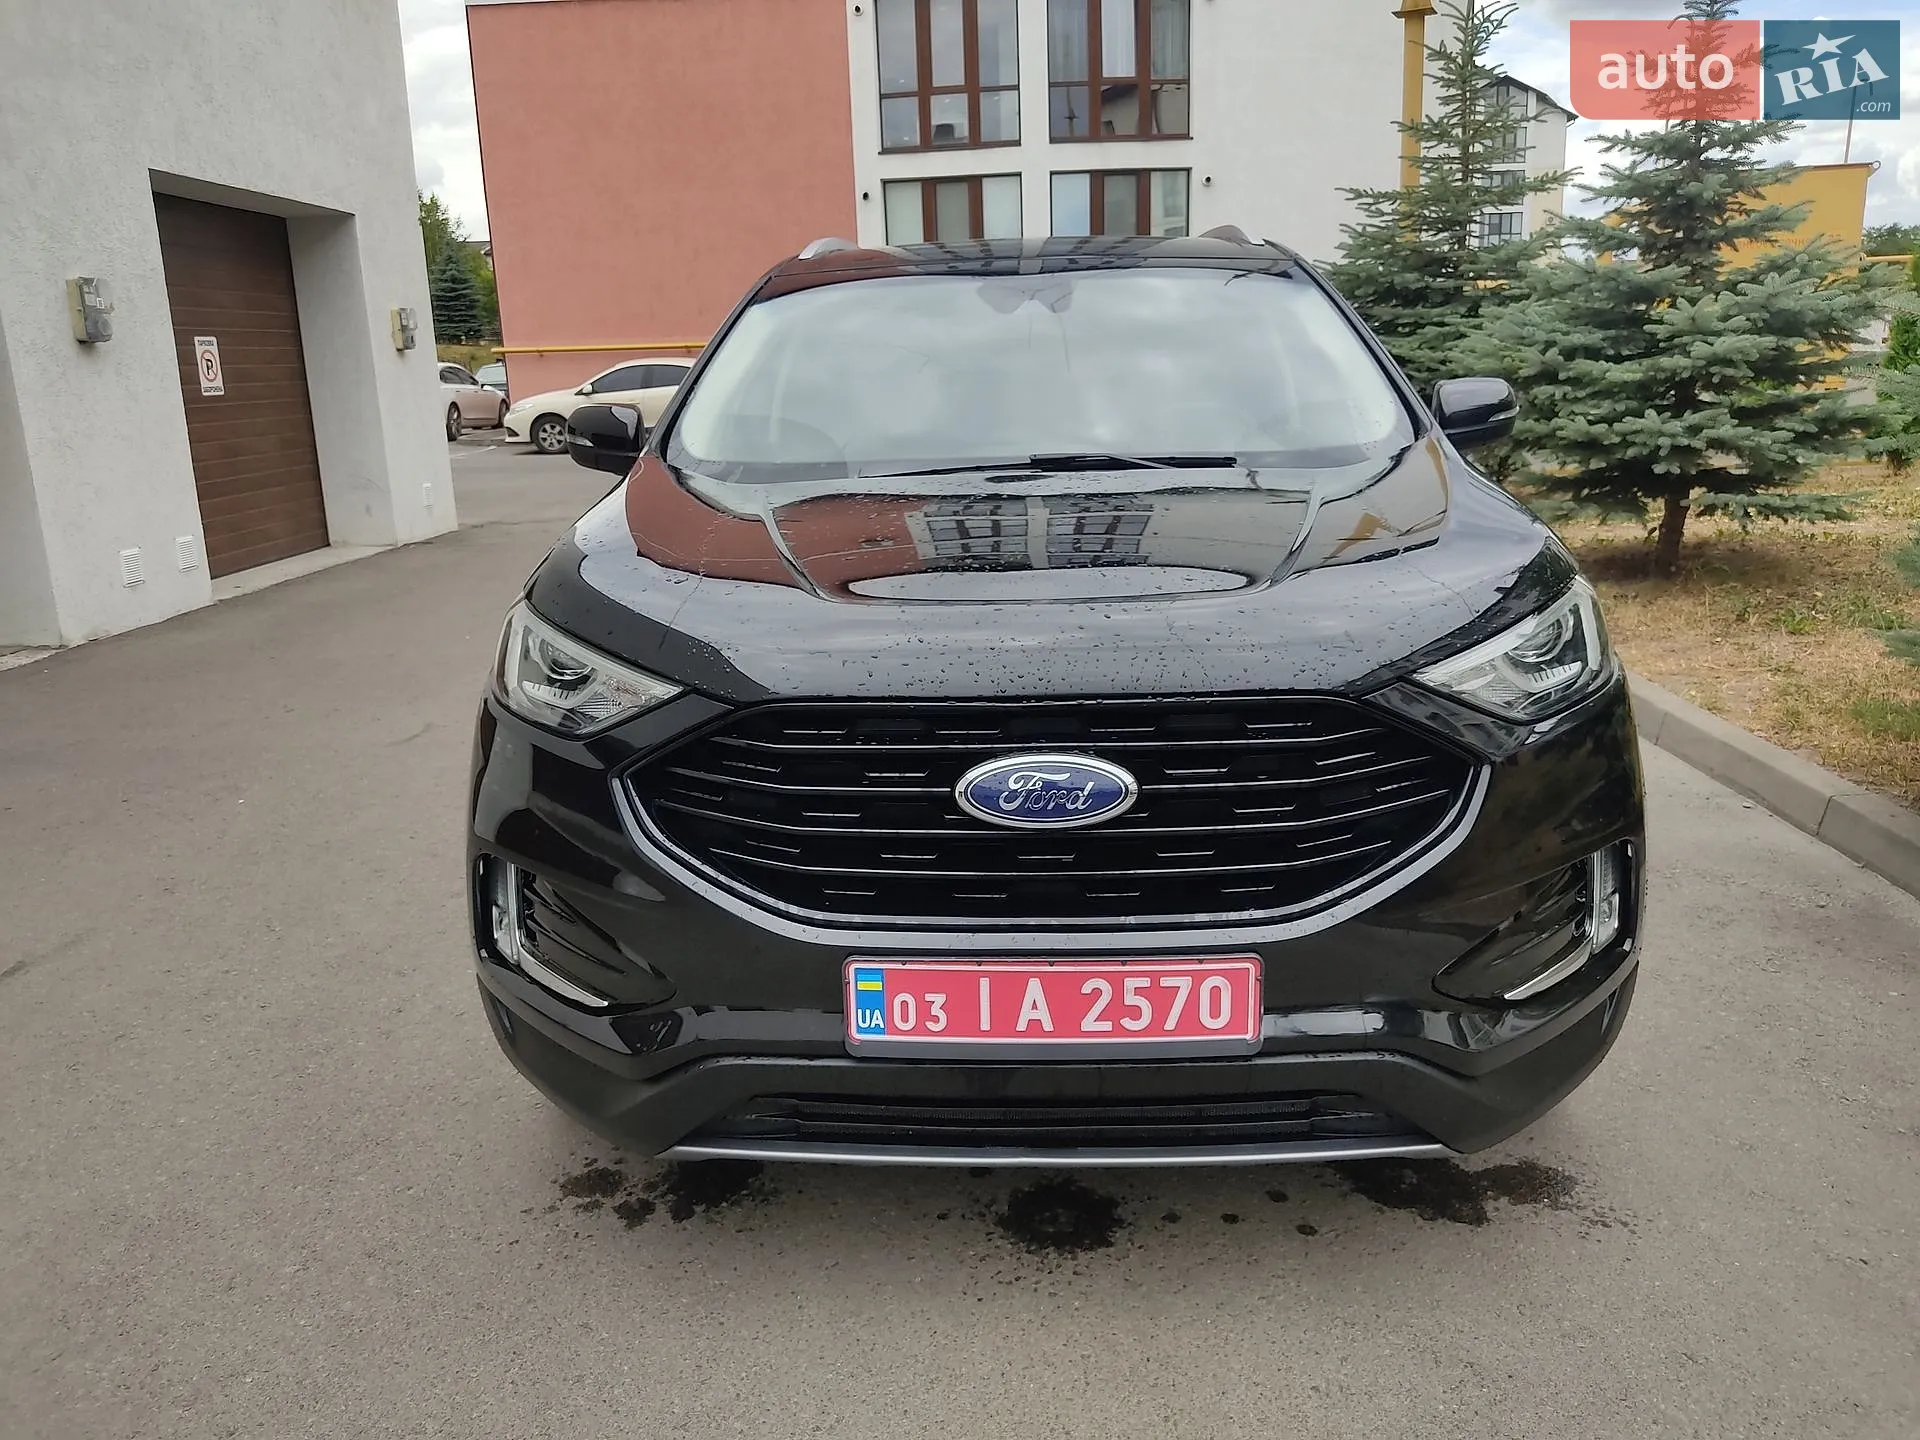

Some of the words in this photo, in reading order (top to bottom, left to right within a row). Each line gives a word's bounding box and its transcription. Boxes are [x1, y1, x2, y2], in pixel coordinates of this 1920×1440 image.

[998, 771, 1095, 811] Ford
[856, 1008, 885, 1029] UA
[892, 992, 948, 1033] 03
[1079, 974, 1232, 1032] 2570
